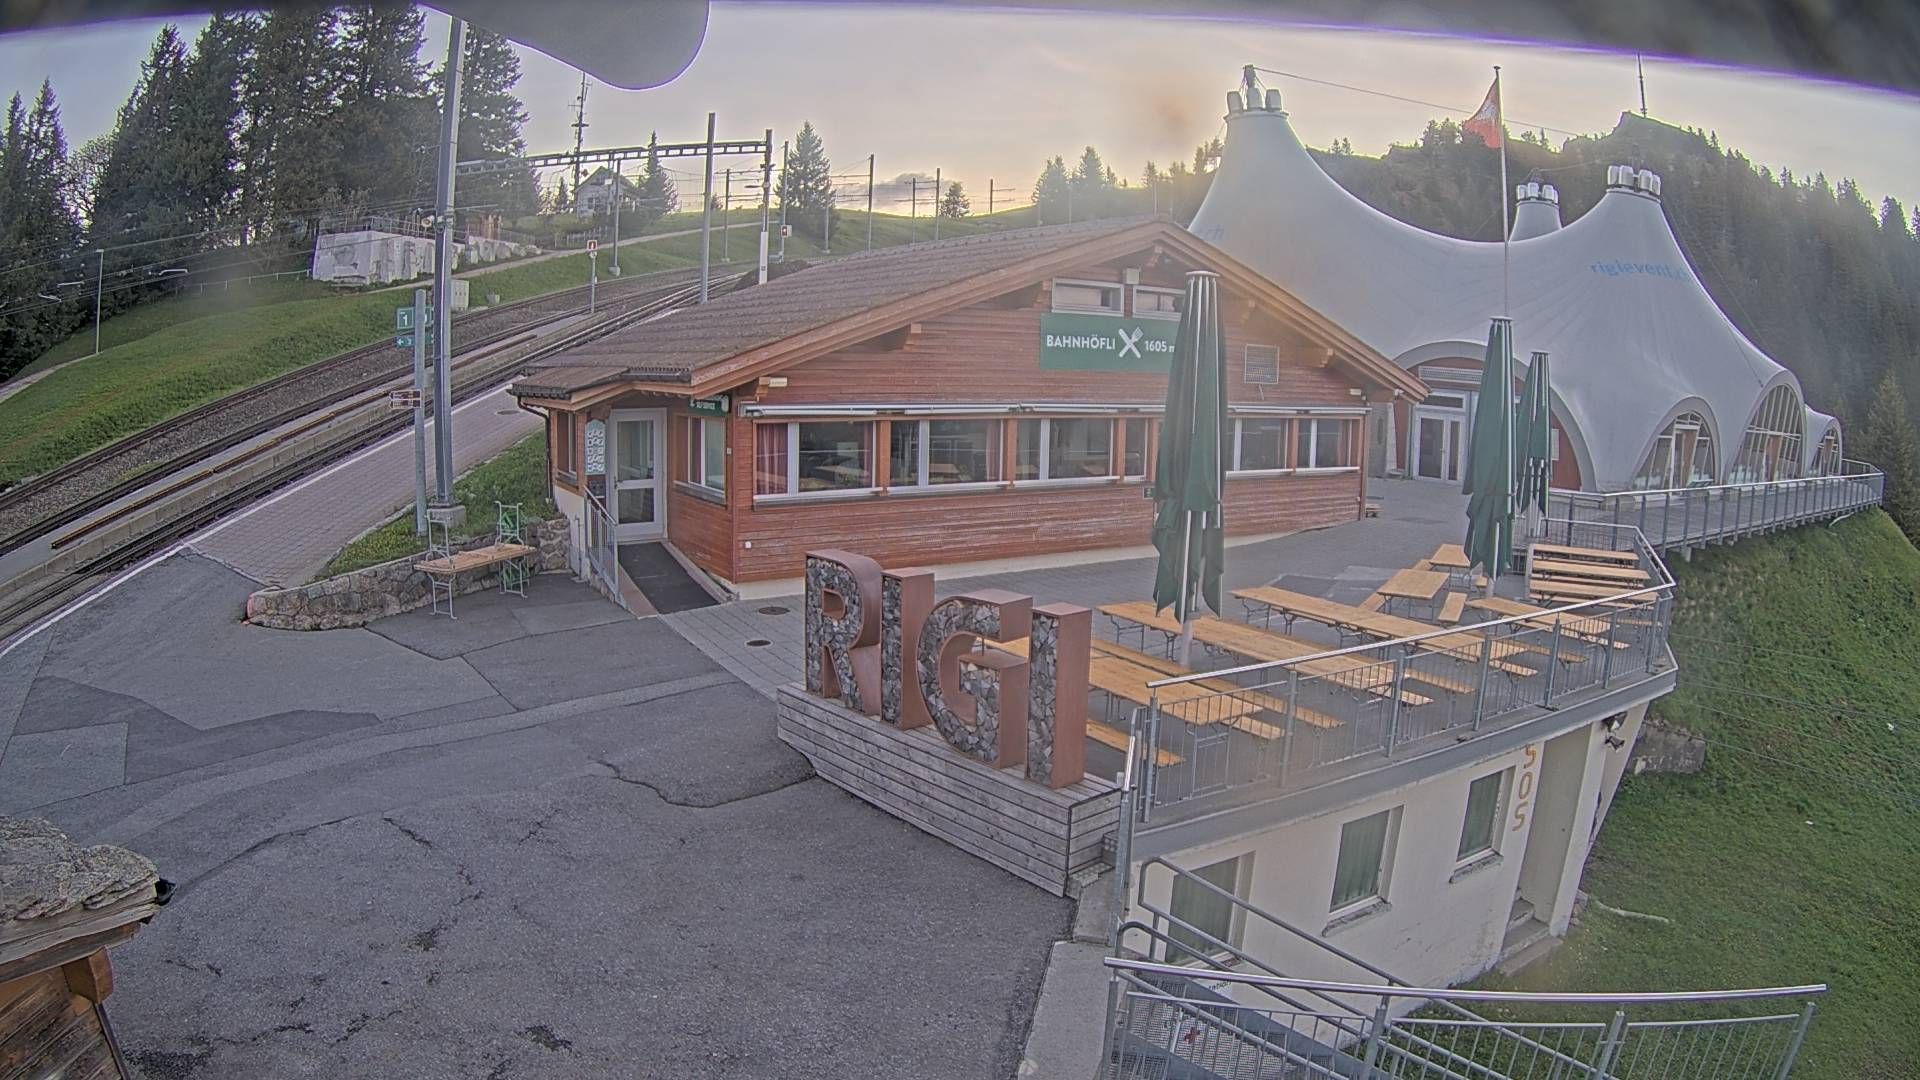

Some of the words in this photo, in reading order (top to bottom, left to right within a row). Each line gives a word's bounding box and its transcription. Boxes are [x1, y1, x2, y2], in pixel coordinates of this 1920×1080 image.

[1046, 334, 1116, 350] BAHNHÖFLI
[1145, 340, 1168, 353] 1605
[805, 549, 1092, 789] RIGI
[1512, 744, 1537, 832] SOS
